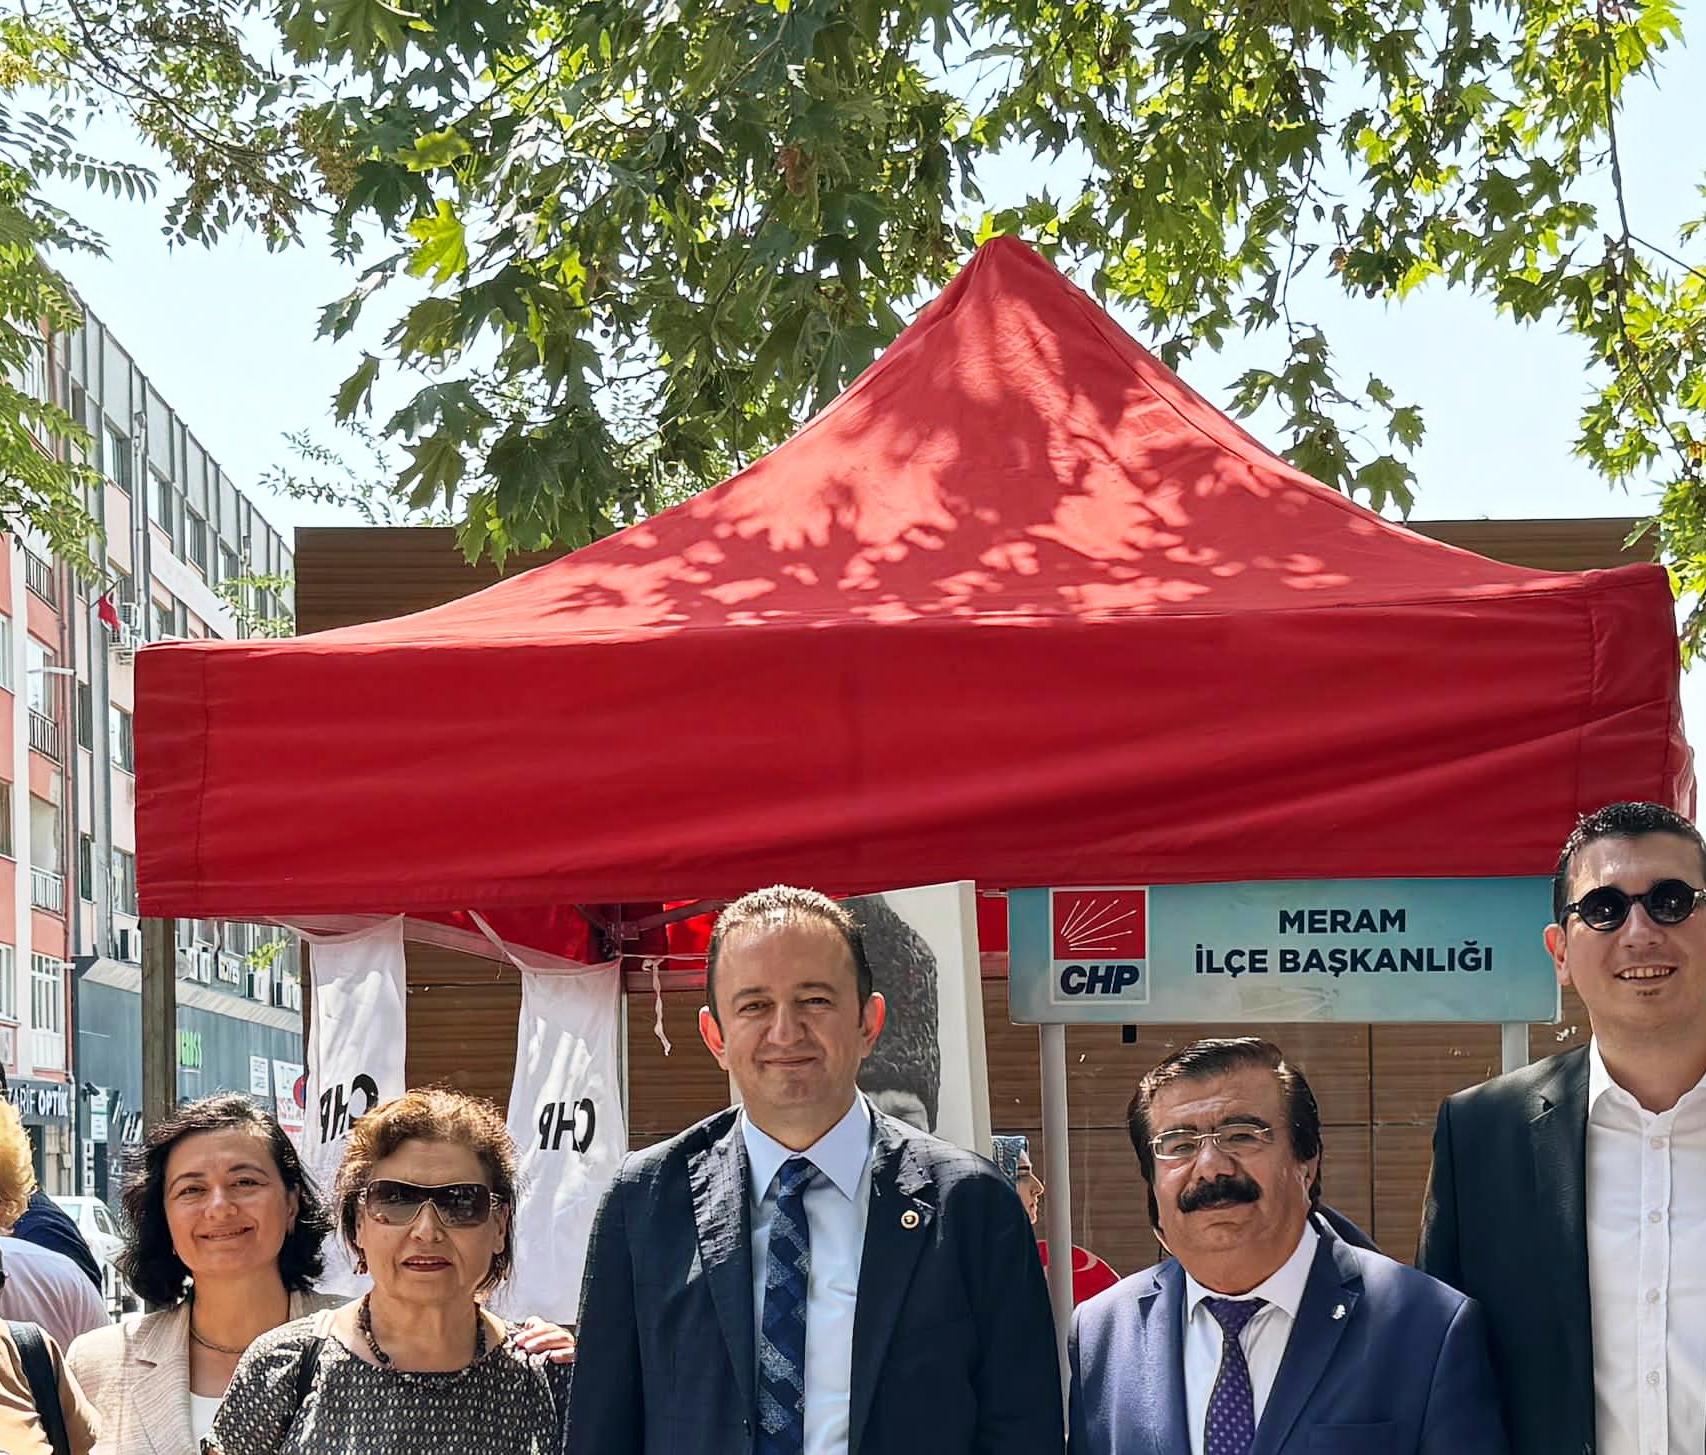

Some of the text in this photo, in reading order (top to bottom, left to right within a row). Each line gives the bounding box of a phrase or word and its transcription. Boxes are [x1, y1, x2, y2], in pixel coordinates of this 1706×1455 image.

[1278, 908, 1406, 934] MERAM
[1195, 940, 1493, 979] İLÇE BAŞKANLIĞI
[1059, 964, 1140, 996] CHP
[38, 1085, 69, 1117] OPTİK
